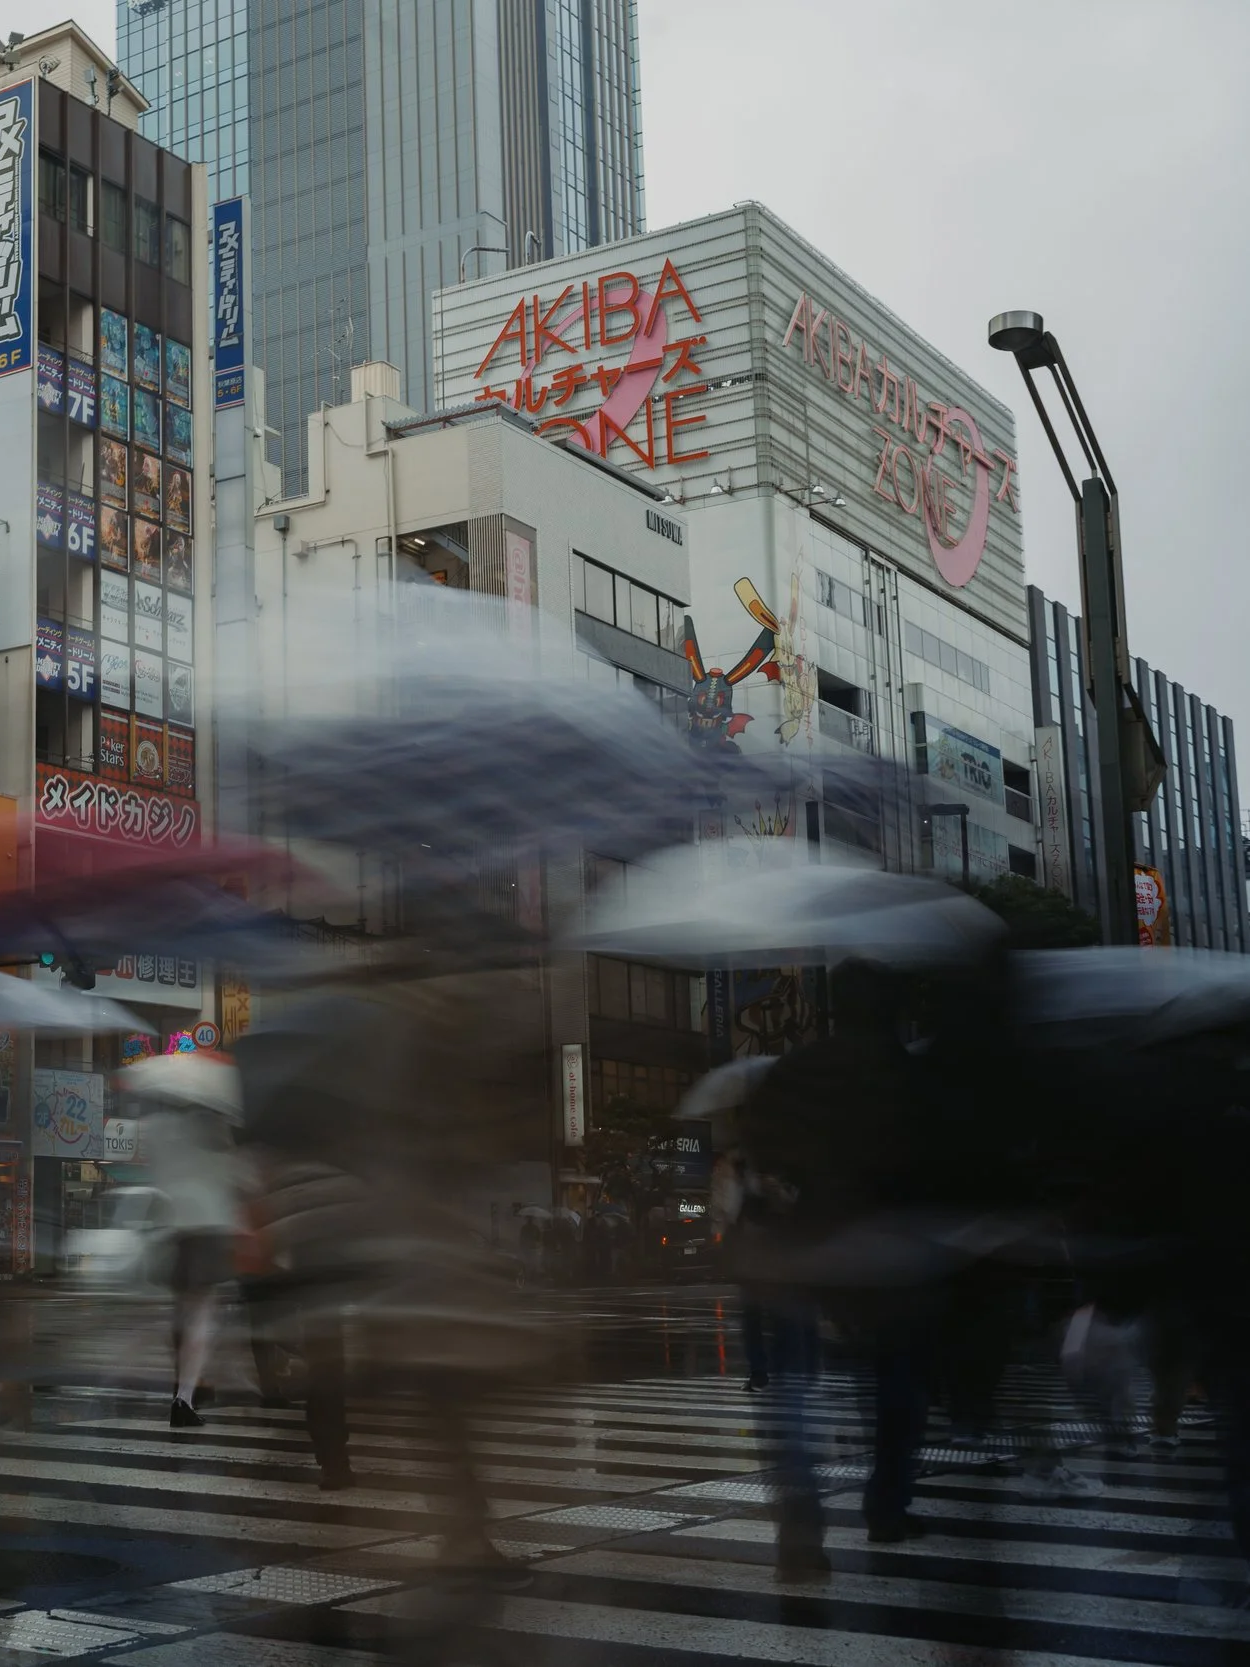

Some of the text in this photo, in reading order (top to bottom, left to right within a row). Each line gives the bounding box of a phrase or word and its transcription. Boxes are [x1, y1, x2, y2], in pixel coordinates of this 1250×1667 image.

[474, 257, 702, 379] AKIBA
[68, 389, 95, 424] 7F
[871, 426, 959, 549] ZONE
[68, 522, 95, 555] 6F
[67, 659, 95, 693] 5F
[100, 749, 125, 767] Stars
[42, 776, 194, 847] メイドカジノ
[198, 1029, 214, 1042] 40
[105, 1137, 134, 1151] TOKIS
